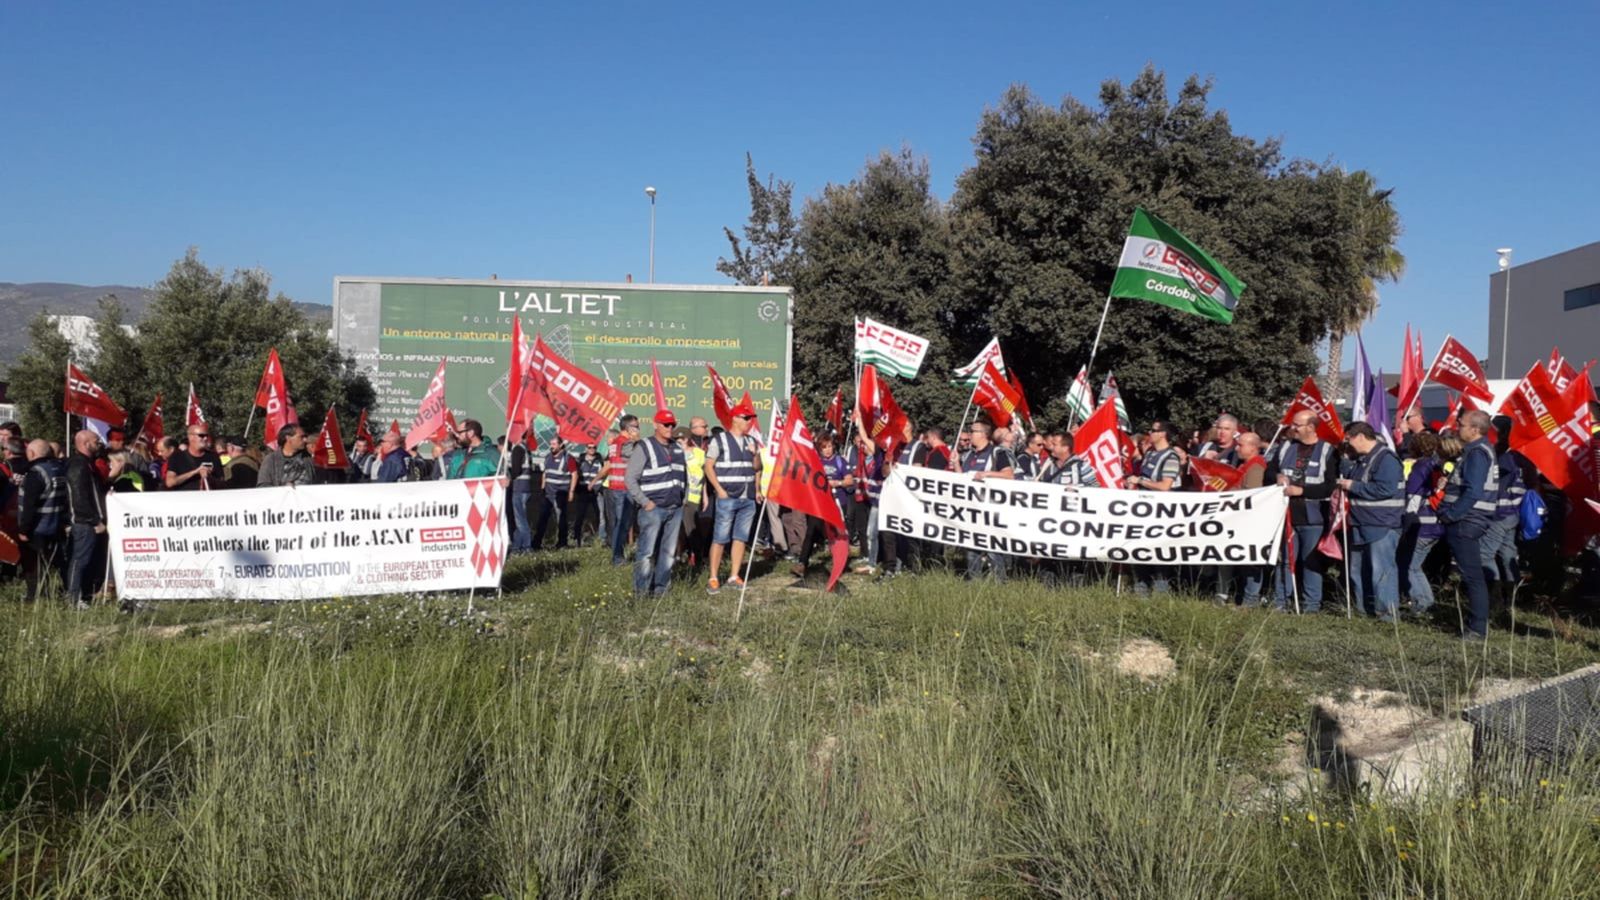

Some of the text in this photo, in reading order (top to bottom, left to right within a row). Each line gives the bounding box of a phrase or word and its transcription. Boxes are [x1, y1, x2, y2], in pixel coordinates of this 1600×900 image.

[1146, 279, 1197, 301] Córdoba
[499, 291, 622, 316] L'ALTET
[581, 320, 687, 330] INDUSTRIAL
[383, 328, 741, 349] Un entorno natural paa el desarrollo empresarial
[732, 360, 778, 370] parcelas
[531, 350, 593, 404] CCOO
[664, 375, 688, 388] m2
[702, 376, 774, 390] 2000 m2
[624, 393, 656, 407] .000
[664, 394, 687, 408] m2
[1520, 377, 1548, 418] CCOO
[905, 475, 1049, 509] DEFENDRE
[149, 514, 163, 528] an
[168, 511, 239, 530] agreement
[244, 510, 257, 526] in
[262, 509, 285, 525] the
[289, 505, 345, 524] textile
[350, 503, 381, 521] and
[388, 501, 459, 519] clothing
[921, 500, 1008, 528] TEXTIL
[1038, 517, 1235, 540] CONFECCIÓ,
[163, 537, 189, 552] that
[193, 536, 243, 554] gathers
[248, 535, 270, 551] the
[274, 535, 303, 553] pact
[310, 531, 327, 549] of
[333, 530, 360, 548] the
[421, 528, 464, 542] CCOO
[886, 514, 913, 533] ES
[923, 522, 1068, 559] DEFENDRE
[124, 540, 158, 551] CCOO
[421, 543, 467, 553] industria
[124, 554, 160, 563] industria
[383, 560, 429, 572] EUROPEAN
[432, 557, 465, 569] TEXTILE
[234, 564, 276, 579] EURATEX
[278, 561, 350, 579] CONVENTION
[366, 572, 409, 584] CLOTHING
[410, 570, 444, 581] SECTOR
